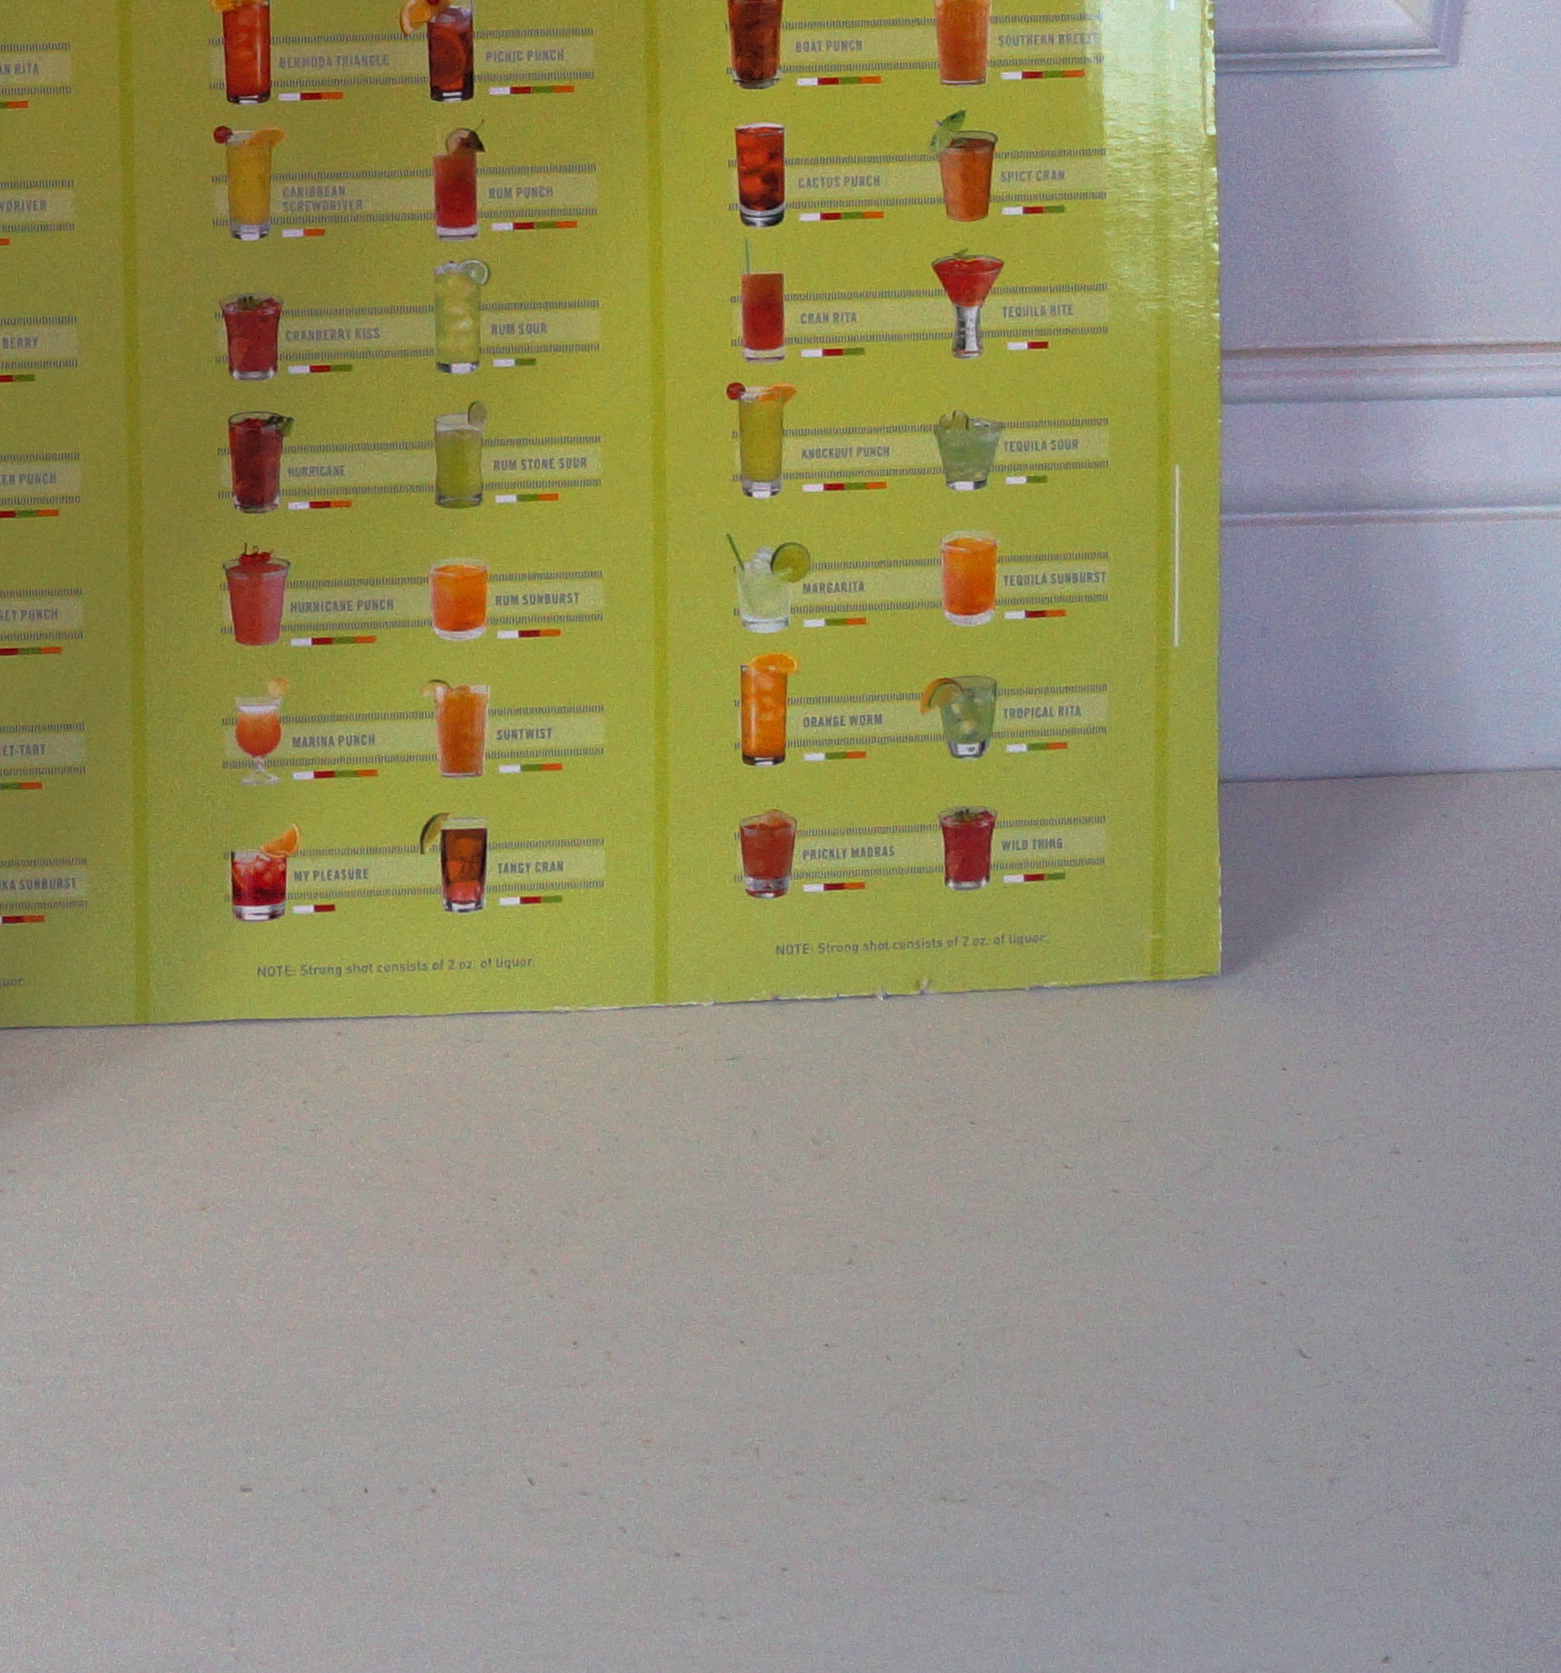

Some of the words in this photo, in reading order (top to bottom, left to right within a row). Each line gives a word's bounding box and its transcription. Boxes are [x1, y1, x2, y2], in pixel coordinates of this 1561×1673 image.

[795, 41, 822, 53] BOAT
[826, 39, 862, 51] PUNCH
[998, 34, 1055, 46] SOUTHERN
[279, 56, 333, 69] BERMUDA
[336, 54, 389, 67] TRIANGLE
[486, 50, 524, 62] PICNIC
[527, 49, 564, 61] PUNCH
[14, 62, 39, 75] RITA
[798, 176, 840, 188] CACTUS
[844, 175, 880, 187] PUNCH
[1000, 171, 1033, 183] SPICY
[1036, 169, 1065, 182] CRAN
[282, 186, 346, 198] CARIBBEAN
[489, 187, 513, 199] RUM
[516, 186, 553, 198] PUNCH
[283, 199, 363, 212] SCREWDRIVER
[800, 313, 828, 325] CRAN
[832, 312, 857, 323] RITA
[1002, 306, 1047, 319] TEQUILA
[286, 329, 352, 341] CRANBERRY
[355, 328, 380, 340] KISS
[491, 324, 515, 336] RUM
[518, 323, 548, 335] SOUR
[2, 337, 38, 348] BERRY
[1004, 440, 1048, 452] TEQUILA
[1051, 439, 1079, 451] SOUR
[802, 447, 854, 459] KNOCKOUT
[856, 446, 890, 458] PUNCH
[494, 459, 517, 471] RUM
[520, 458, 554, 470] STONE
[557, 457, 587, 469] SOUR
[287, 465, 345, 478] HURRICANE
[20, 473, 57, 485] PUNCH
[1004, 573, 1048, 586] TEQUILA
[1051, 572, 1107, 584] SUNBURST
[802, 582, 865, 594] MARGARITA
[290, 599, 353, 613] HURRICANE
[356, 599, 394, 612] PUNCH
[495, 594, 519, 606] RUM
[522, 593, 580, 605] SUNBURST
[21, 608, 58, 621] PUNCH
[1003, 706, 1054, 719] TROPICAL
[1058, 705, 1082, 717] RITA
[803, 715, 846, 728] ORANGE
[849, 714, 883, 726] WORM
[292, 735, 336, 747] MARINA
[338, 734, 375, 746] PUNCH
[497, 728, 552, 740] SUNTWIST
[1001, 839, 1030, 850] WILD
[1032, 838, 1063, 849] THING
[803, 847, 847, 860] PRICKLY
[850, 846, 895, 858] MADRAS
[497, 862, 532, 874] TANGY
[536, 861, 564, 872] CRAN
[294, 869, 310, 881] MY
[312, 868, 369, 881] PLEASURE
[19, 877, 77, 891] SUNBURST
[818, 941, 859, 956] Strong
[863, 940, 889, 952] shot
[893, 938, 943, 951] consists
[947, 937, 958, 948] of
[962, 936, 970, 947] 2
[993, 934, 1005, 945] of
[299, 963, 342, 978] Strong
[346, 962, 374, 974] shot
[377, 961, 428, 973] consists
[432, 959, 444, 970] of
[448, 959, 455, 970] 2
[480, 958, 492, 969] of
